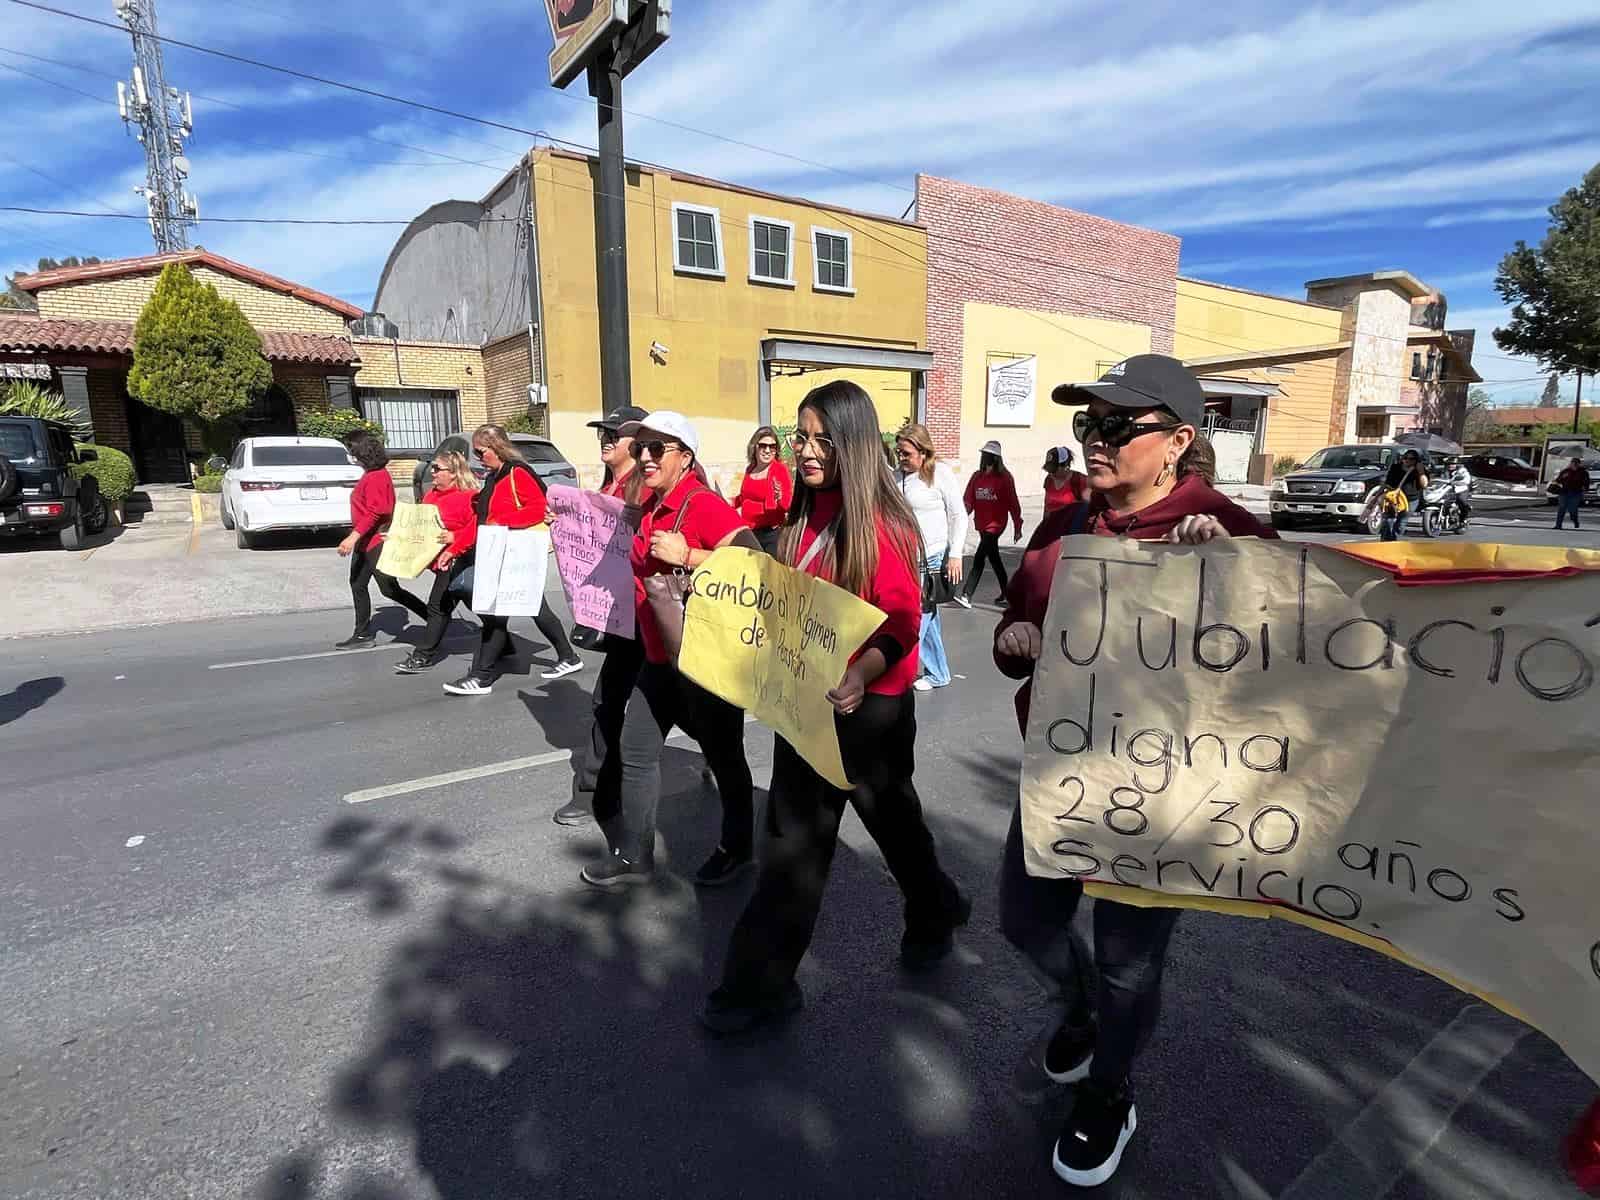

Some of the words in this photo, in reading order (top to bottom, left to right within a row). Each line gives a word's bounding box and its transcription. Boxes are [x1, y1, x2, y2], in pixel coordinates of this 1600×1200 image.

[692, 570, 775, 611] Cambio
[741, 617, 765, 648] de
[1047, 672, 1290, 794] digna
[1053, 775, 1300, 855] 28/30
[1337, 840, 1525, 922] años
